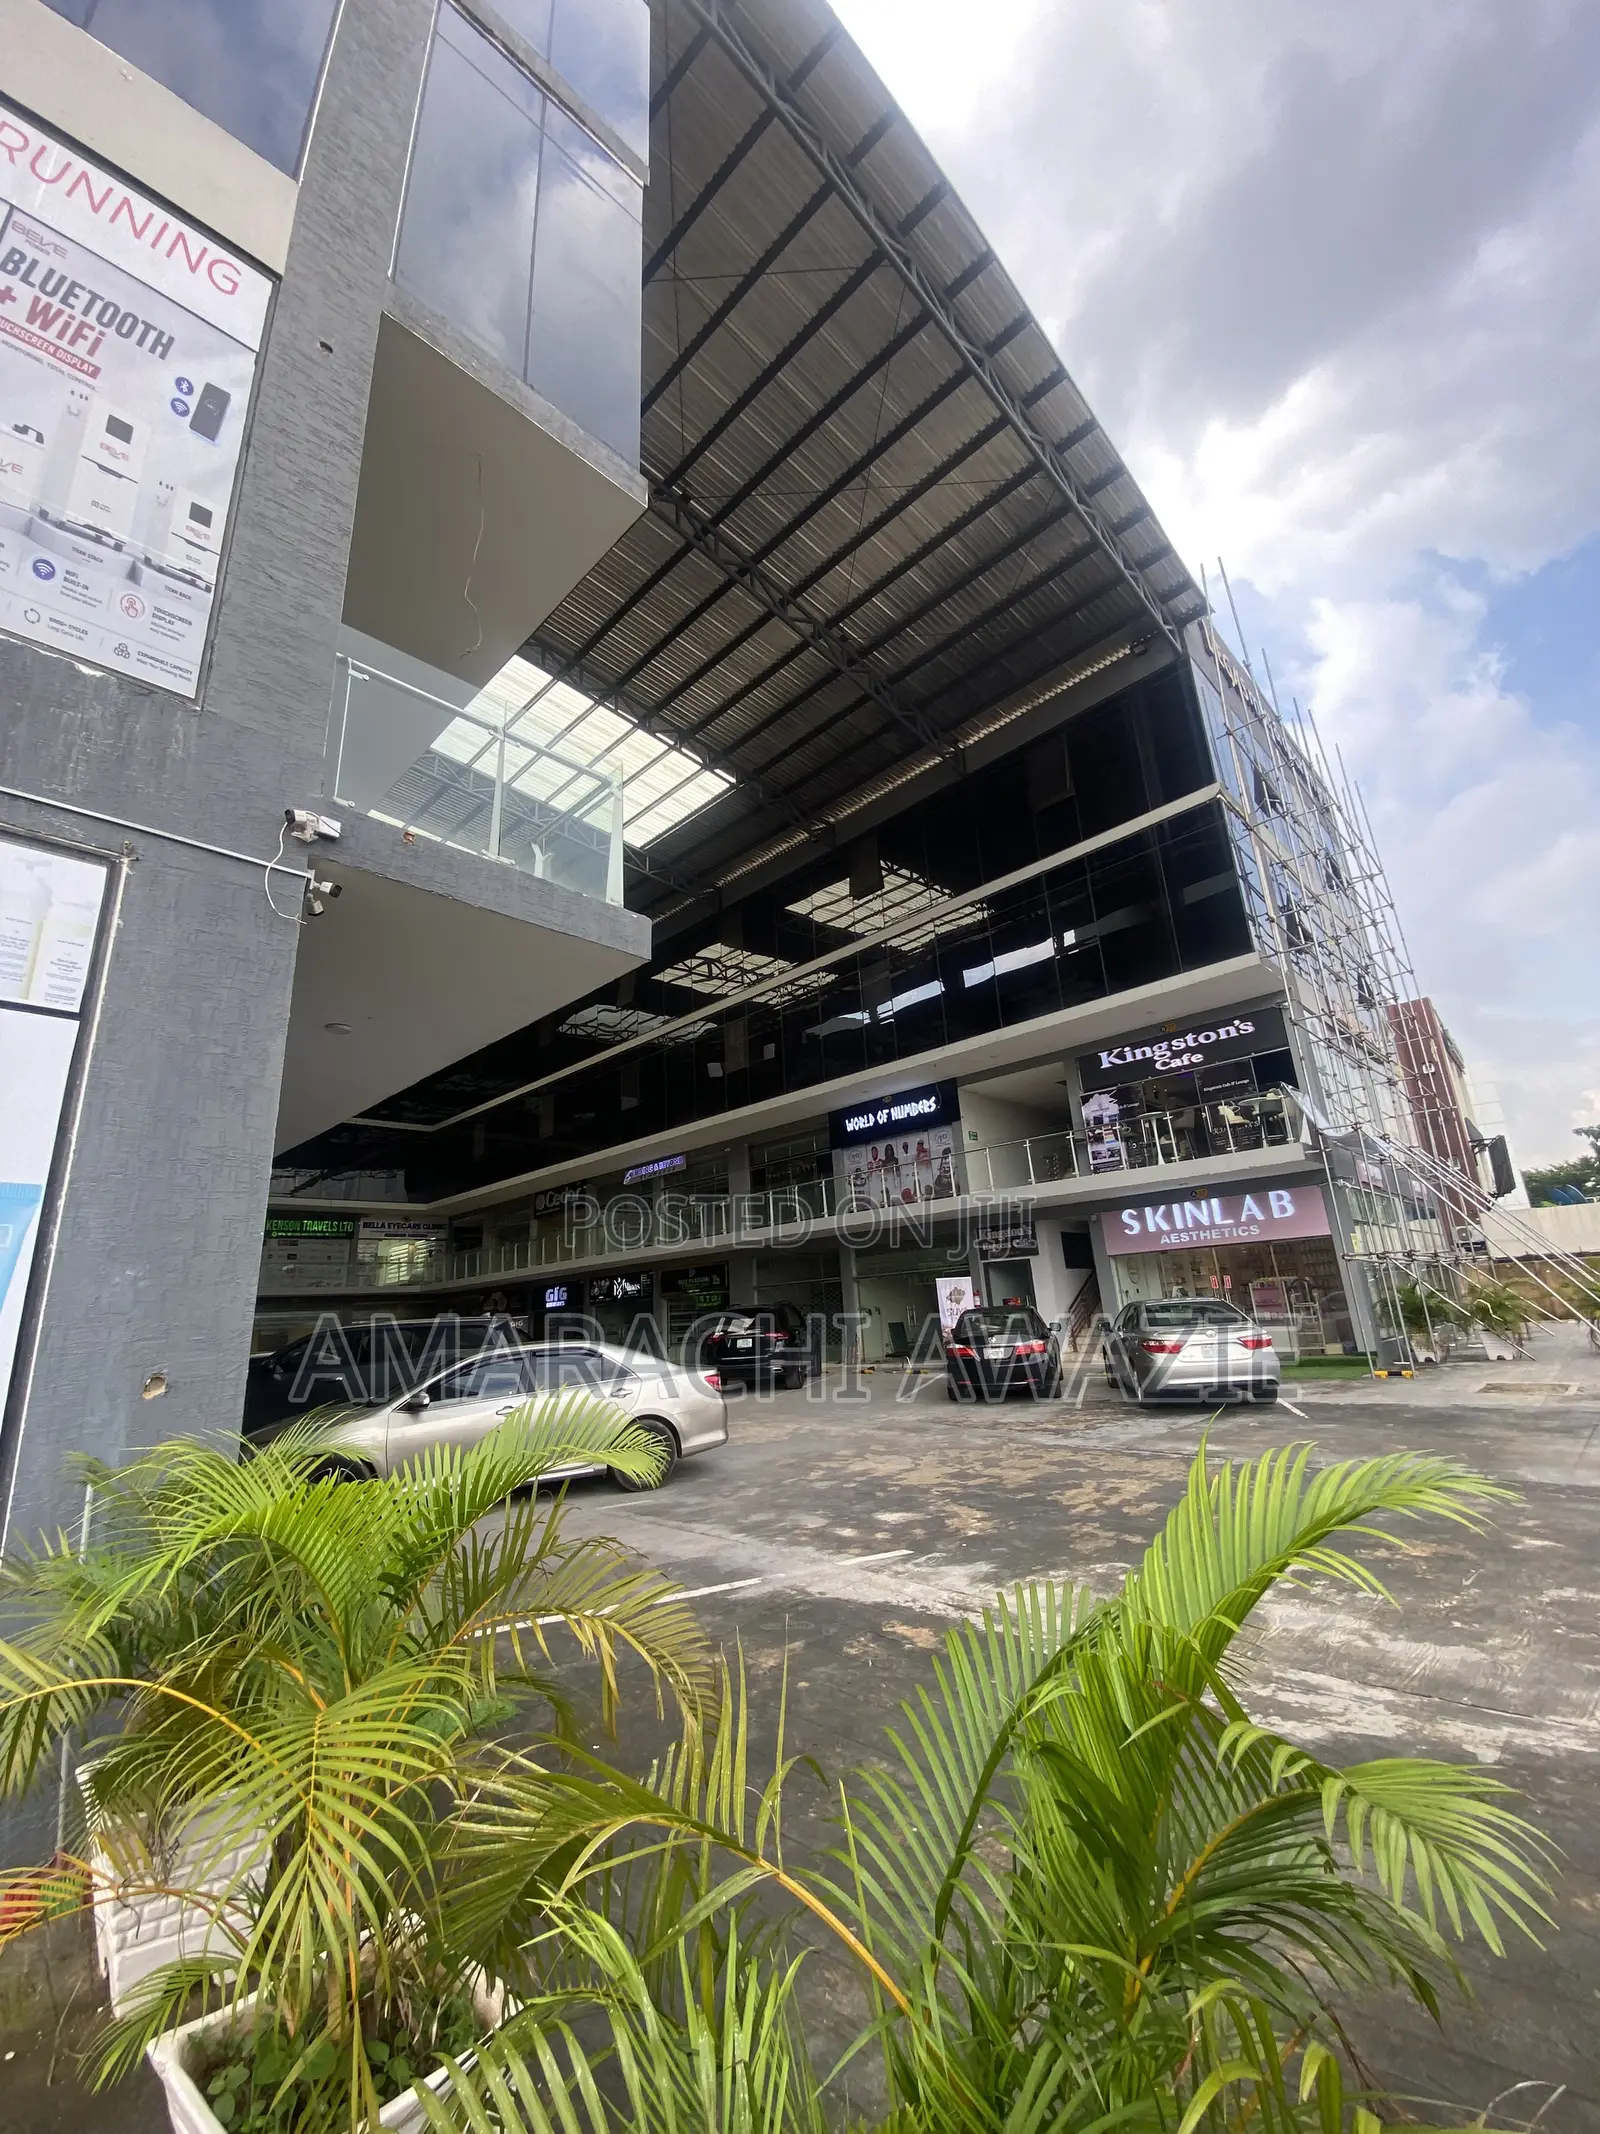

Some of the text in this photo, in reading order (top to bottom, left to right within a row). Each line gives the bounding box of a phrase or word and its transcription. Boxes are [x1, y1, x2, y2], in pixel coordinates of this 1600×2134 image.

[0, 121, 242, 295] RUNNING
[0, 247, 175, 360] BLUETOOTH
[25, 295, 106, 357] WiFi
[169, 662, 193, 676] CAPACITY
[1098, 1019, 1256, 1069] Kingston's
[1155, 1052, 1204, 1071] Cafe
[845, 1096, 937, 1132] WORLD OF NUMBERS
[1121, 1189, 1296, 1235] SKINLAB
[266, 1219, 354, 1232] KENSON TRAVELS LTD
[363, 1221, 386, 1229] BELLA
[387, 1222, 422, 1230] EYECARE
[979, 1225, 1032, 1241] Kingston's
[1160, 1224, 1260, 1244] AESTHETICS
[947, 1307, 967, 1316] SUY
